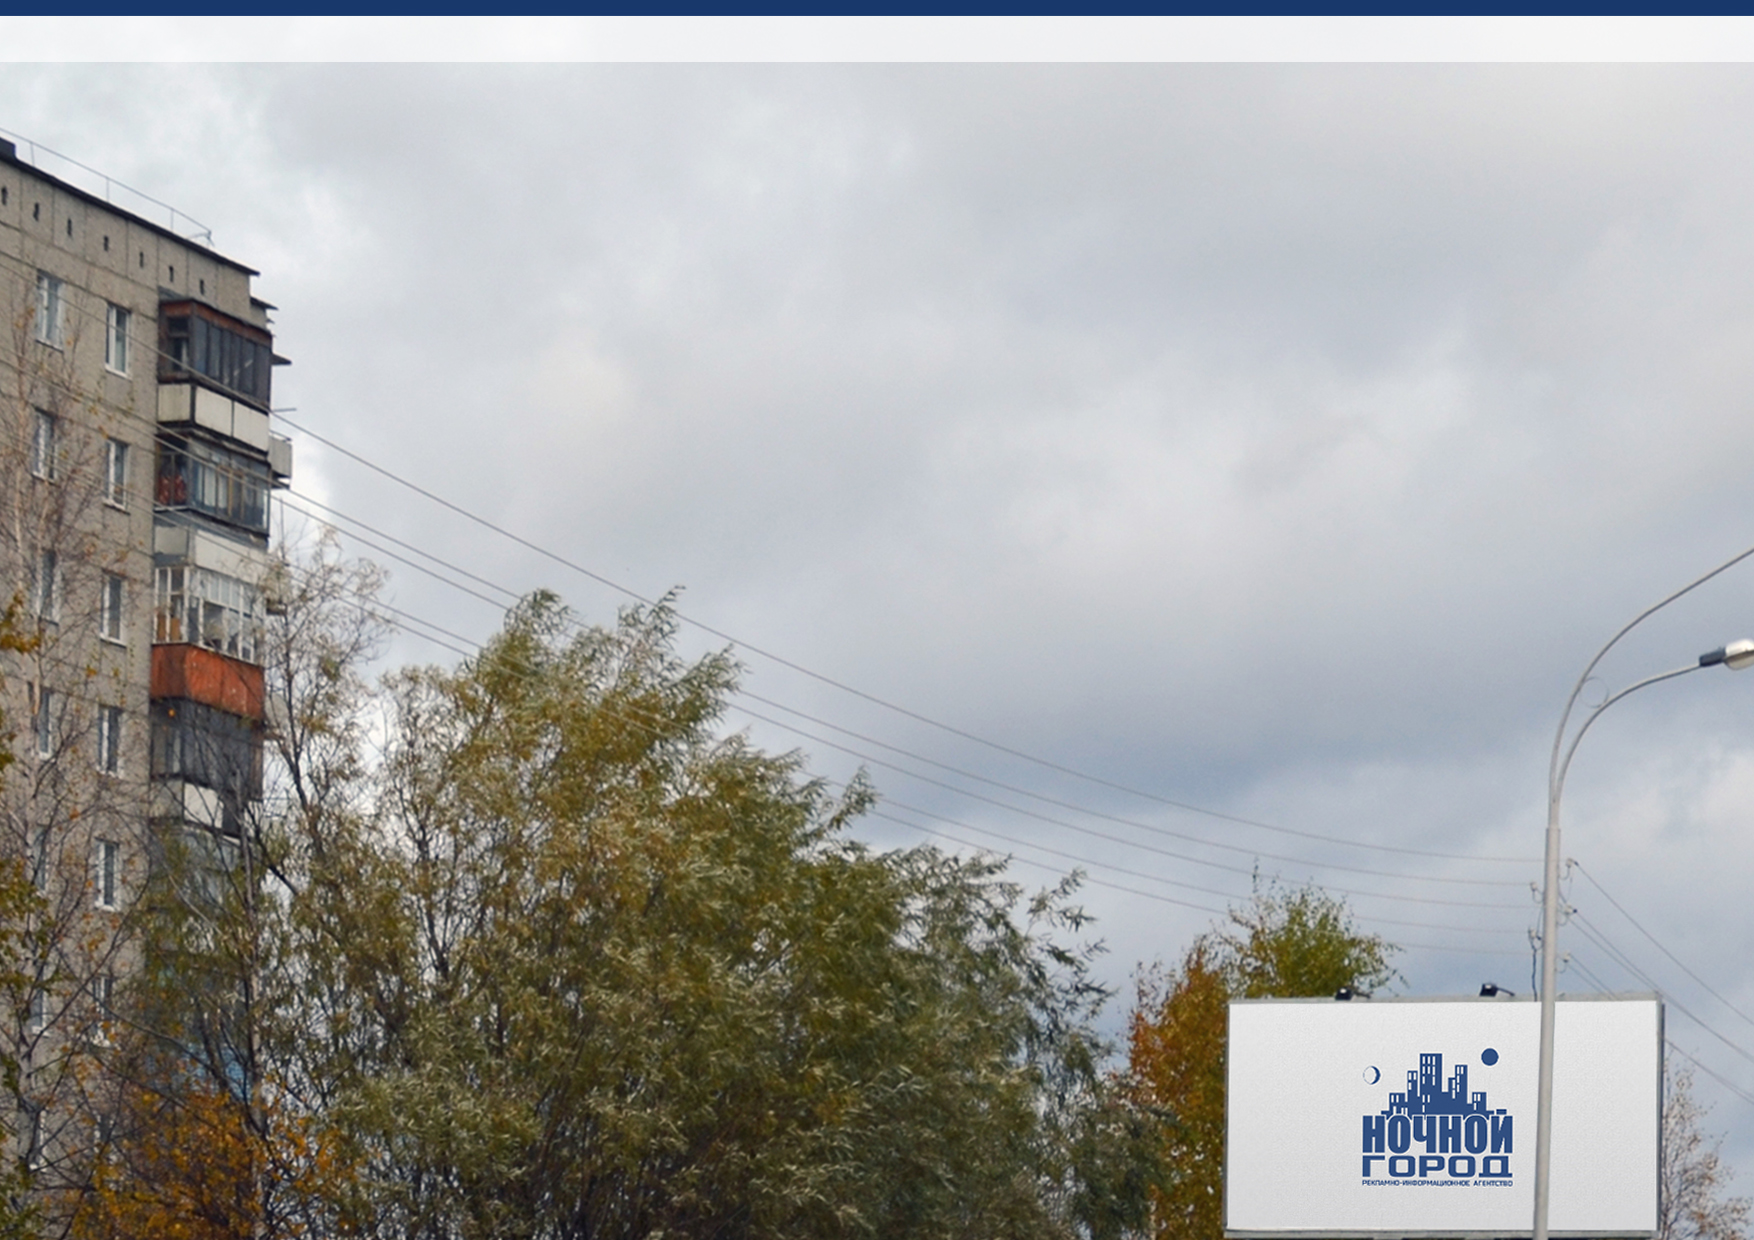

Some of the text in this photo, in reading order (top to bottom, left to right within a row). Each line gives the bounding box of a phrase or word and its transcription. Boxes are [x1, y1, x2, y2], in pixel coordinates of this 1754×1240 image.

[1362, 1109, 1513, 1154] НОЧНОЙ
[1362, 1155, 1513, 1178] ГОРОД
[1362, 1179, 1513, 1187] РЕКЛАМНО-ИНФОРМАЦИОННОЕ АГЕНТСТВО
